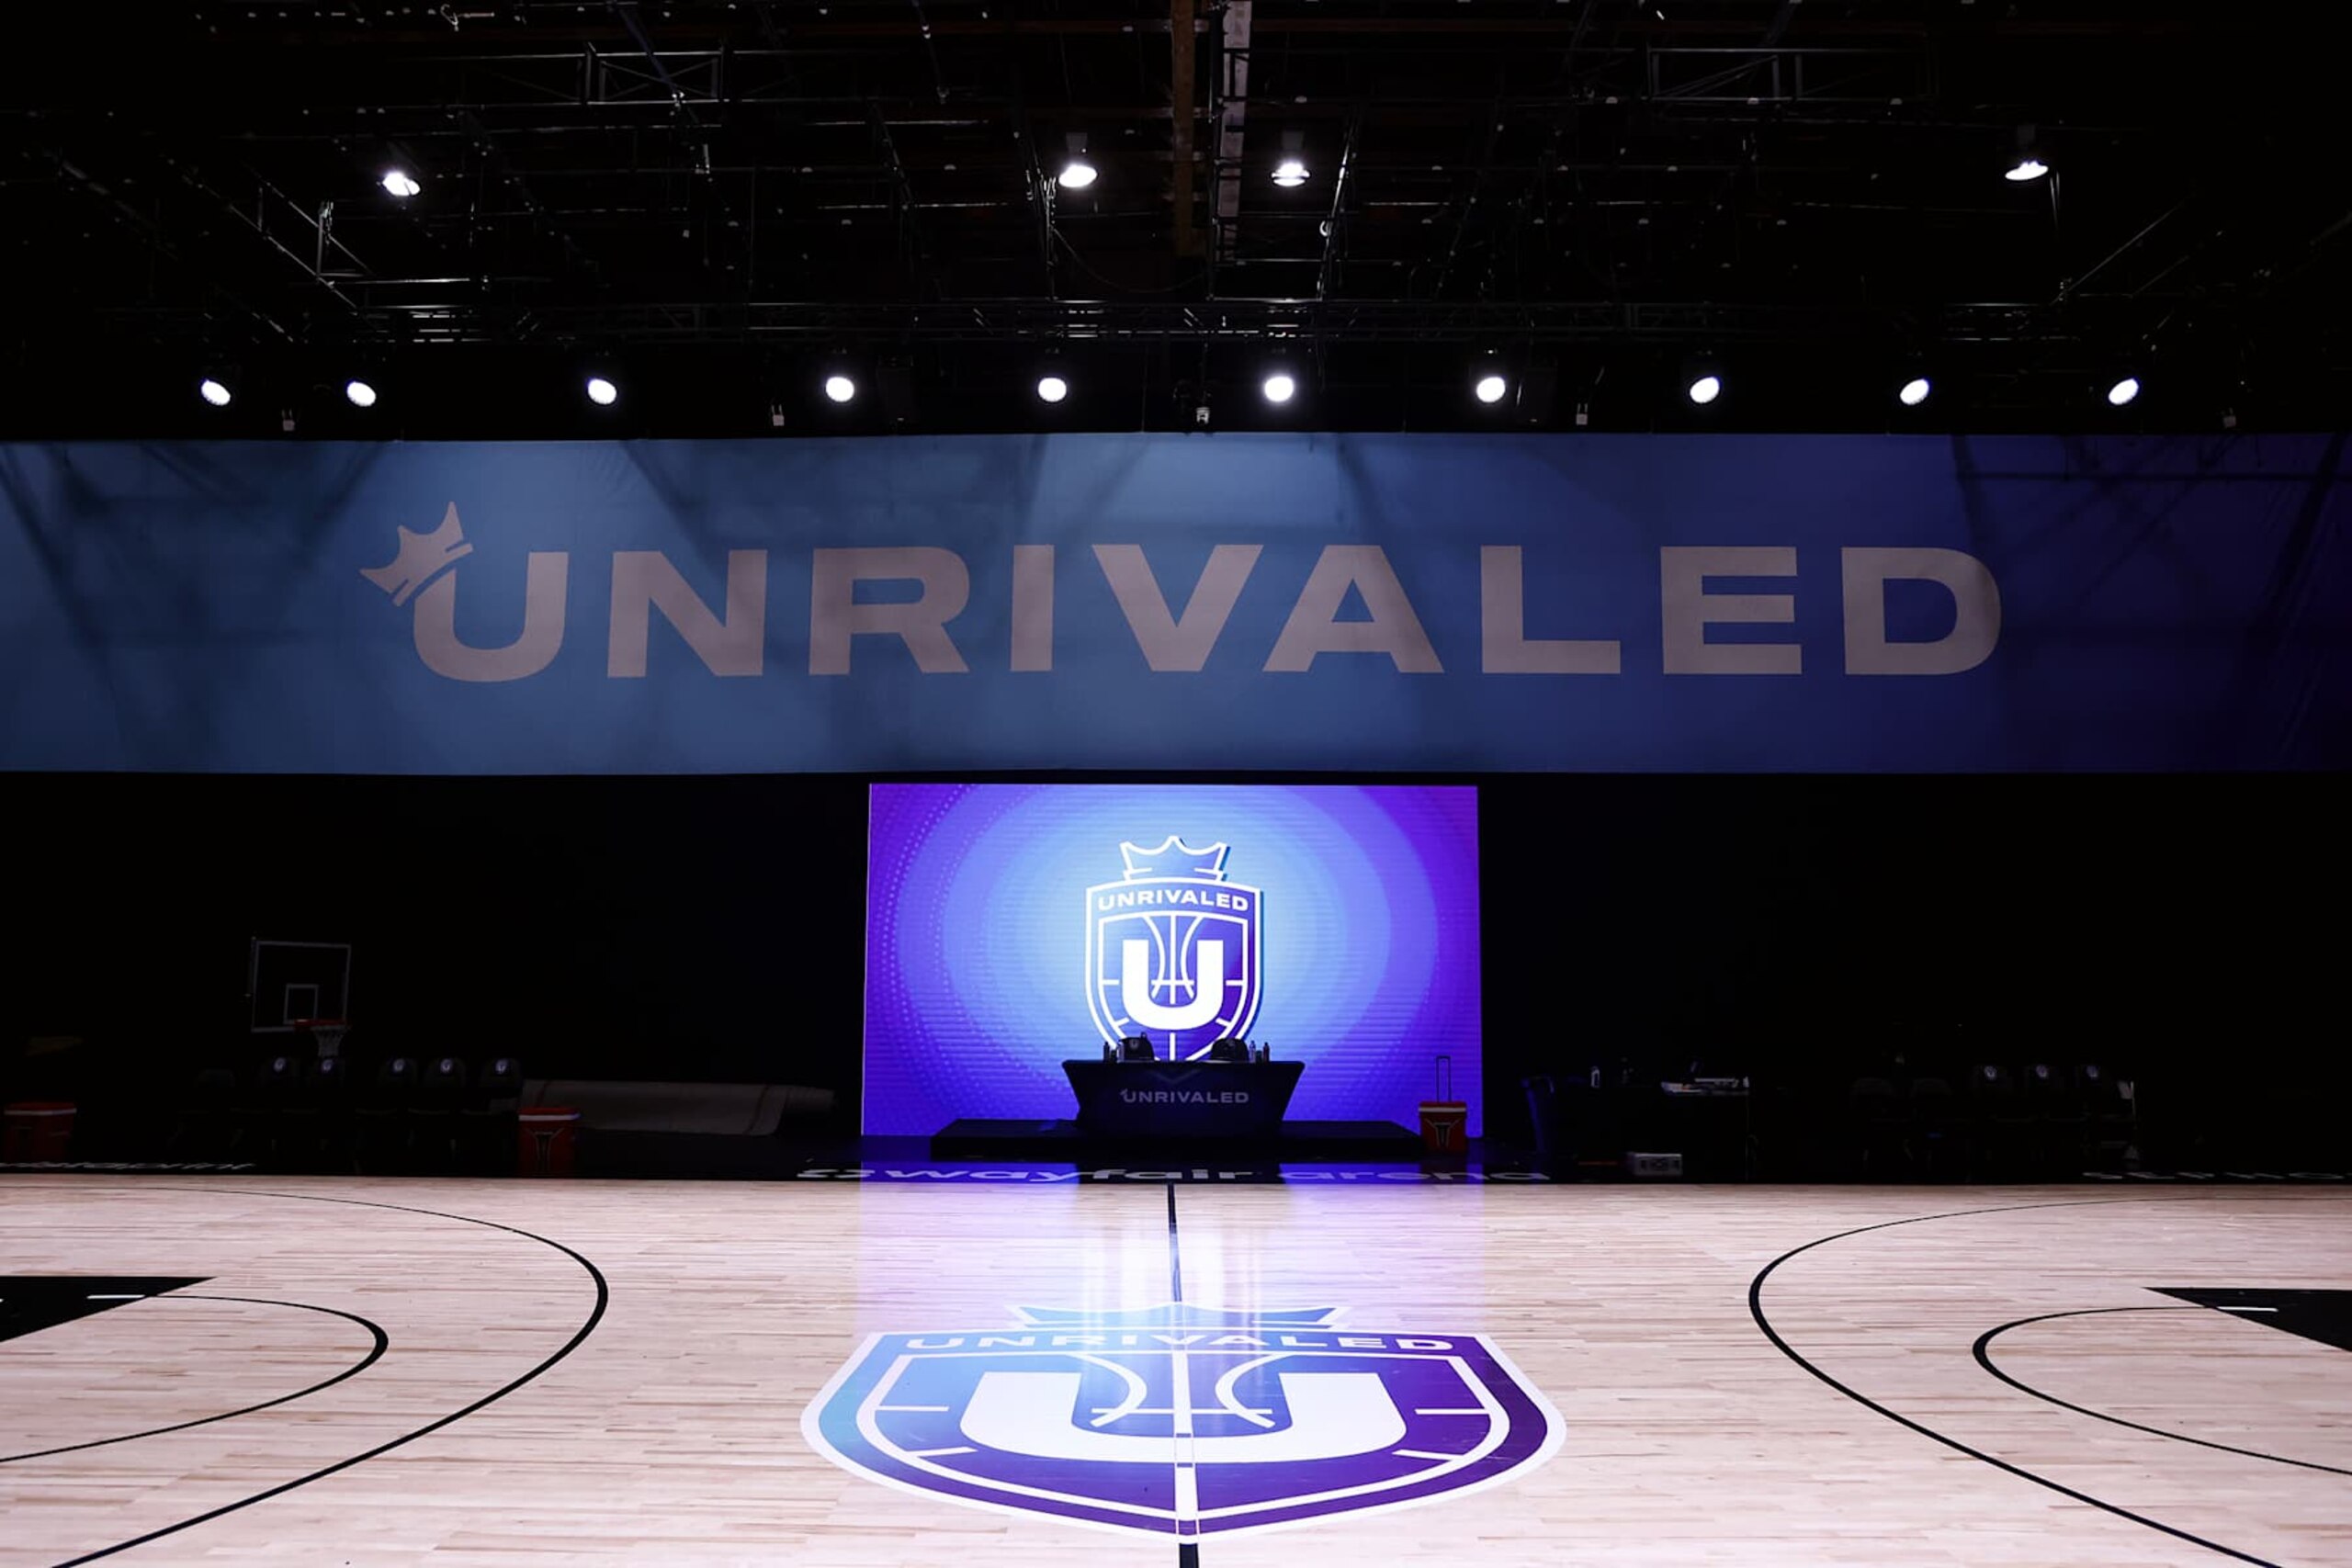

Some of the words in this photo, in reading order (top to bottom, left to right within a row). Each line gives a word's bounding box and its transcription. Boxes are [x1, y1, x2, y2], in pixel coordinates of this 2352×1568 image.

[413, 545, 2002, 682] UNRIVALED
[1098, 889, 1249, 912] UNRIVALED
[1123, 1090, 1250, 1104] UNRIVALED
[884, 1168, 1255, 1182] wayfair
[1277, 1171, 1552, 1180] arena
[905, 1335, 1455, 1352] UNRIVALED
